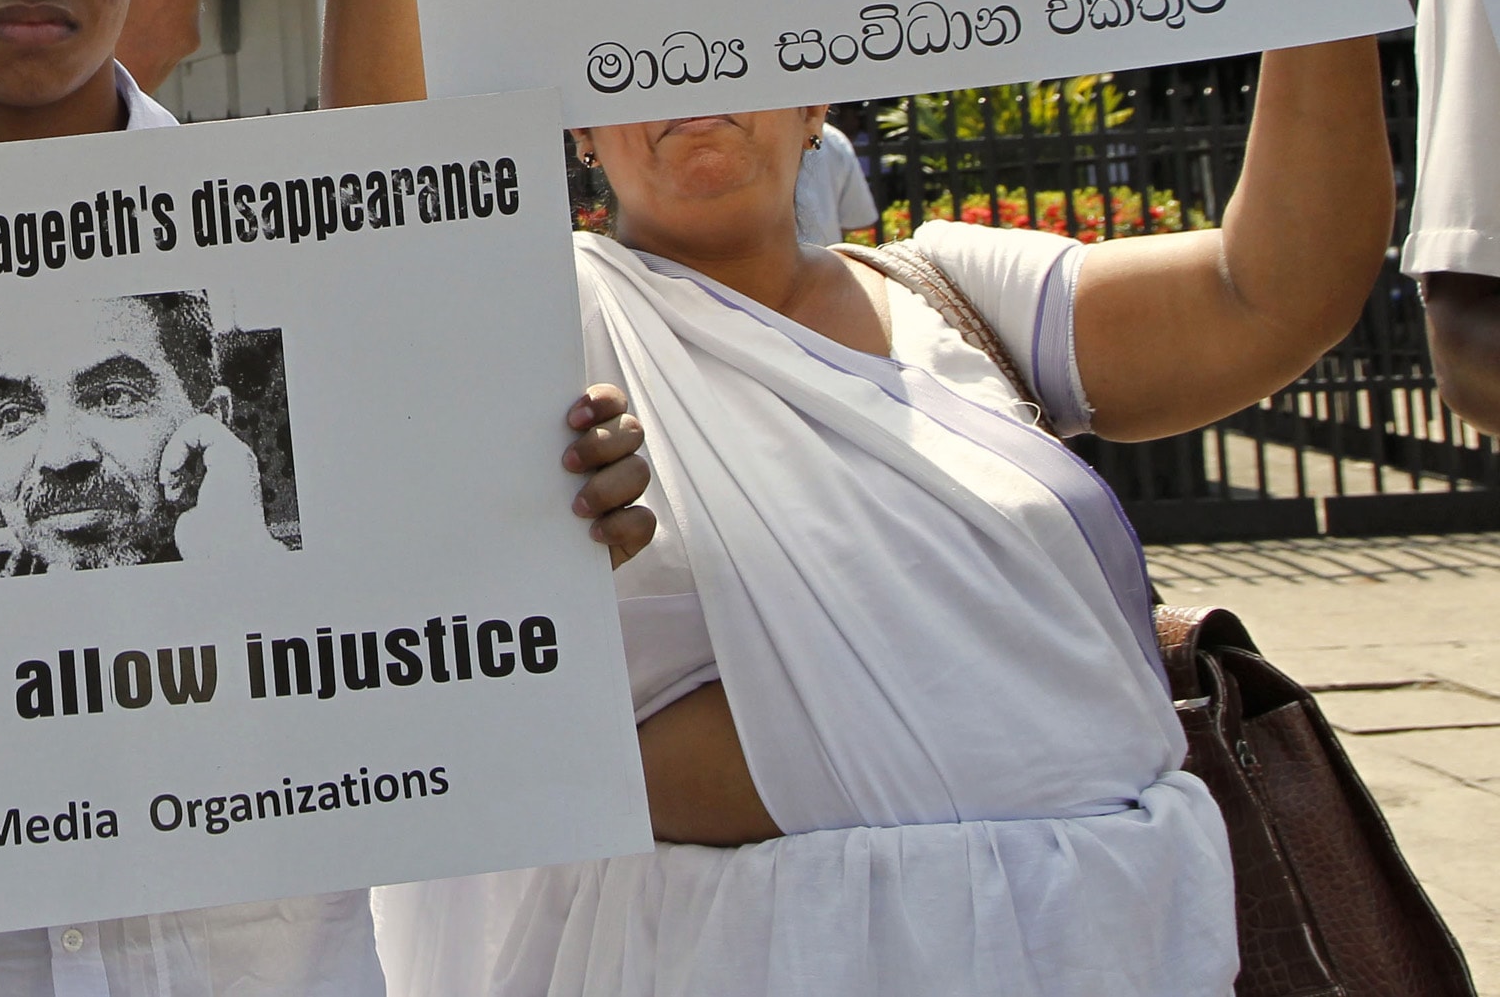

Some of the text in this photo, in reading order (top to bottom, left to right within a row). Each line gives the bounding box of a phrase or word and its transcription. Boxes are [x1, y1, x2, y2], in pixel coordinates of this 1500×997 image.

[774, 2, 1021, 71] සංවිධාන
[192, 158, 519, 247] disappearance
[16, 645, 217, 719] allow
[246, 615, 558, 699] injustice
[150, 767, 448, 834] Organizations
